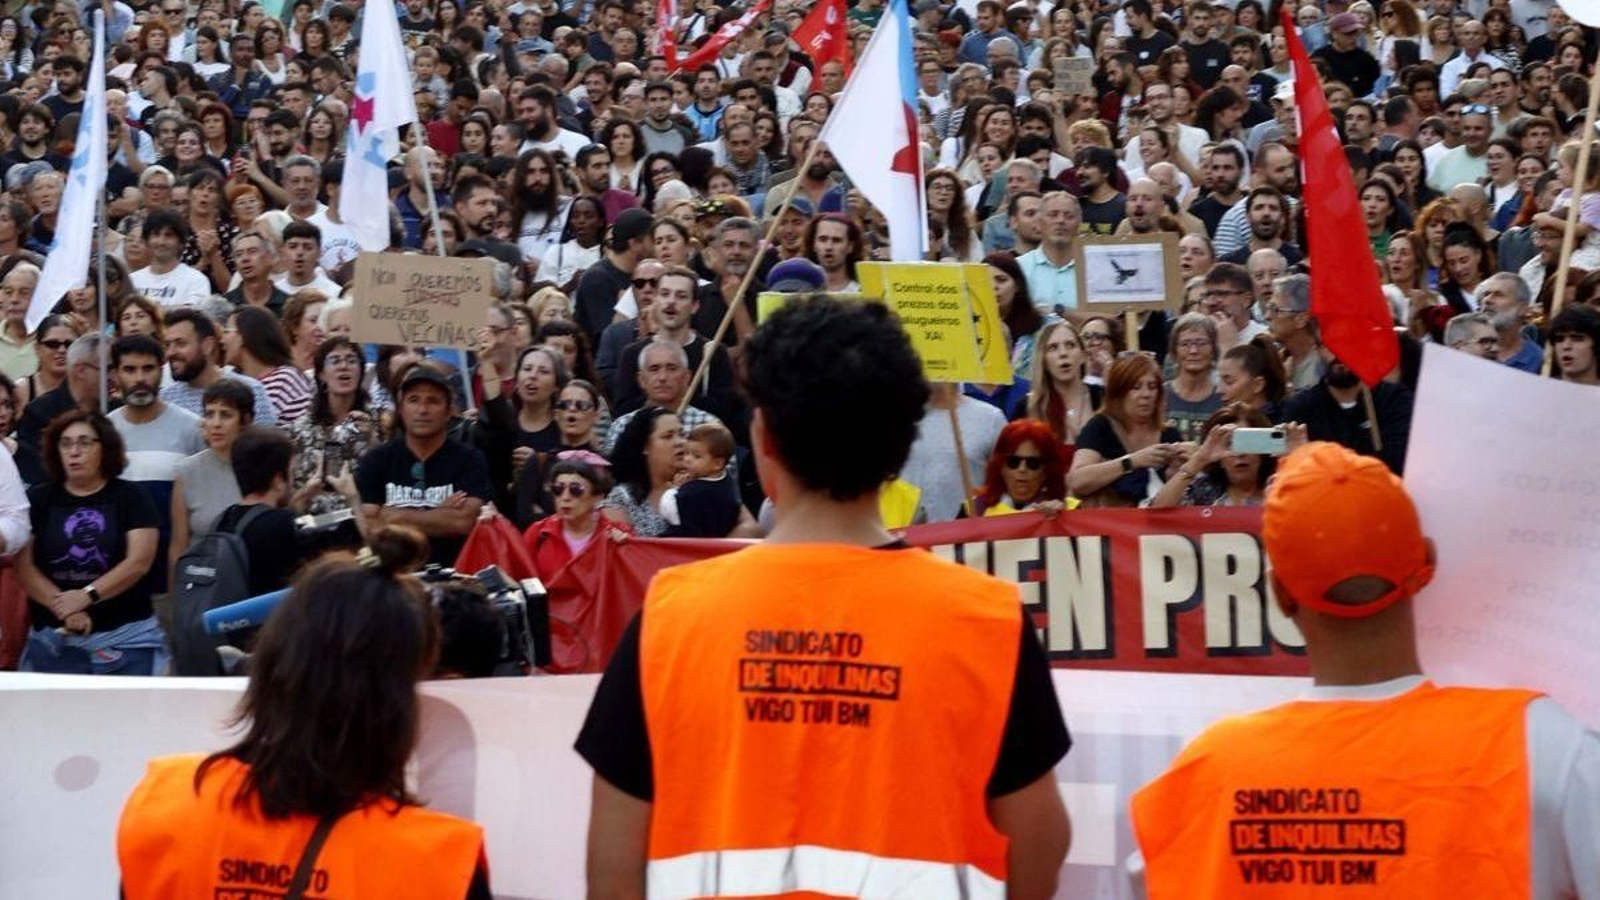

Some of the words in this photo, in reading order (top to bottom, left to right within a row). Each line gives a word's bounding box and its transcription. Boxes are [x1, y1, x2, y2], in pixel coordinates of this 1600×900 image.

[410, 272, 482, 293] QUEREMOS
[893, 282, 933, 294] Control
[937, 284, 958, 294] dos
[368, 304, 430, 323] QUEREMOS
[897, 300, 934, 310] prezos
[938, 301, 960, 310] dos
[397, 321, 480, 347] VECIÑAS
[930, 536, 1110, 654] EN
[746, 630, 863, 658] SINDICATO
[743, 661, 773, 688] DE
[776, 662, 897, 696] INQUILINAS
[746, 698, 794, 722] VIGO
[801, 700, 833, 724] TUI
[838, 702, 870, 728] BM
[1234, 789, 1359, 815] SINDICATO
[1235, 824, 1267, 850] DE
[1270, 824, 1400, 852] INQUILINAS
[220, 859, 329, 893] SINDICO
[1239, 858, 1294, 884] VIGO
[1299, 860, 1335, 885] TUI
[1341, 860, 1377, 885] BM
